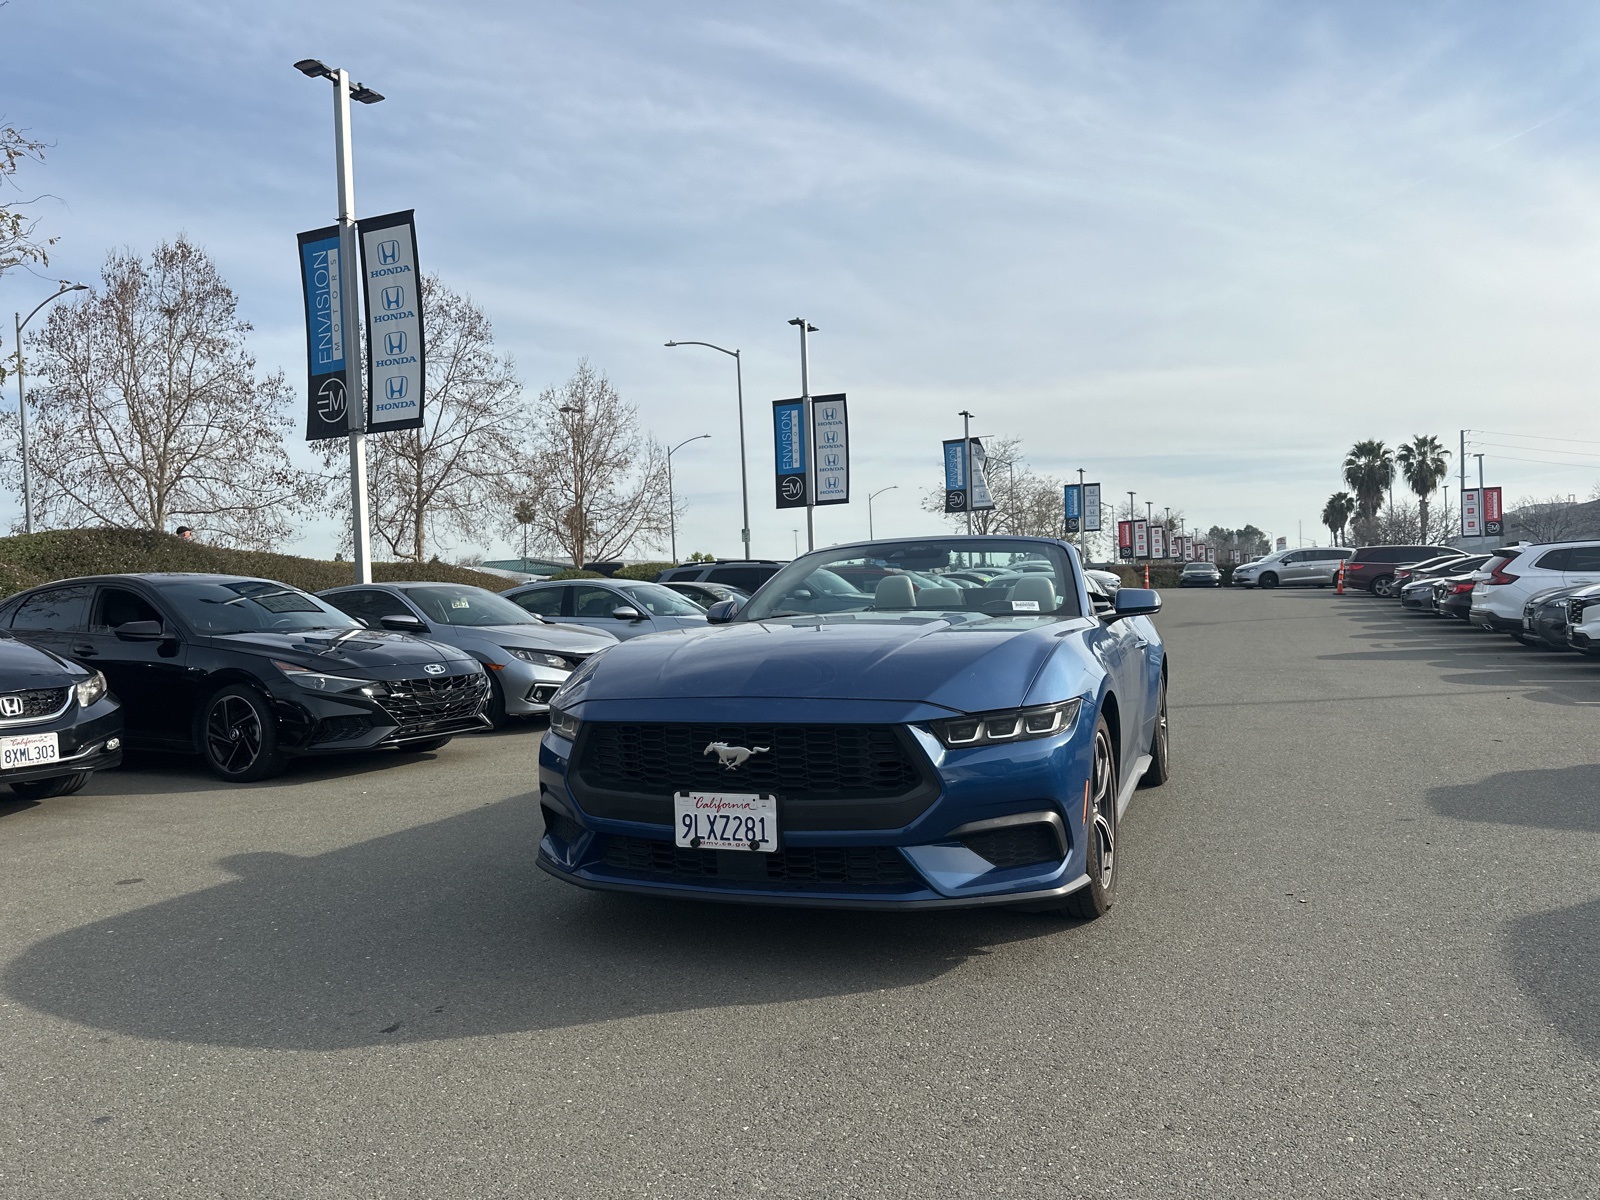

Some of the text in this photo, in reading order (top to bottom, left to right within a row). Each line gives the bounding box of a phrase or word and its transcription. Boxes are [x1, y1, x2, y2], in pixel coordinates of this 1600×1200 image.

[370, 265, 412, 278] HONDA
[312, 250, 333, 364] ENVISION
[330, 258, 341, 351] MOTORS
[373, 310, 415, 323] HONDA
[375, 356, 417, 368] HONDA
[375, 400, 417, 412] HONDA
[781, 410, 793, 470] ENVISION
[949, 447, 957, 487] ENVISION
[12, 737, 47, 747] California
[4, 744, 56, 764] 8XML303
[695, 796, 757, 813] California
[682, 813, 770, 843] 9LXZ281
